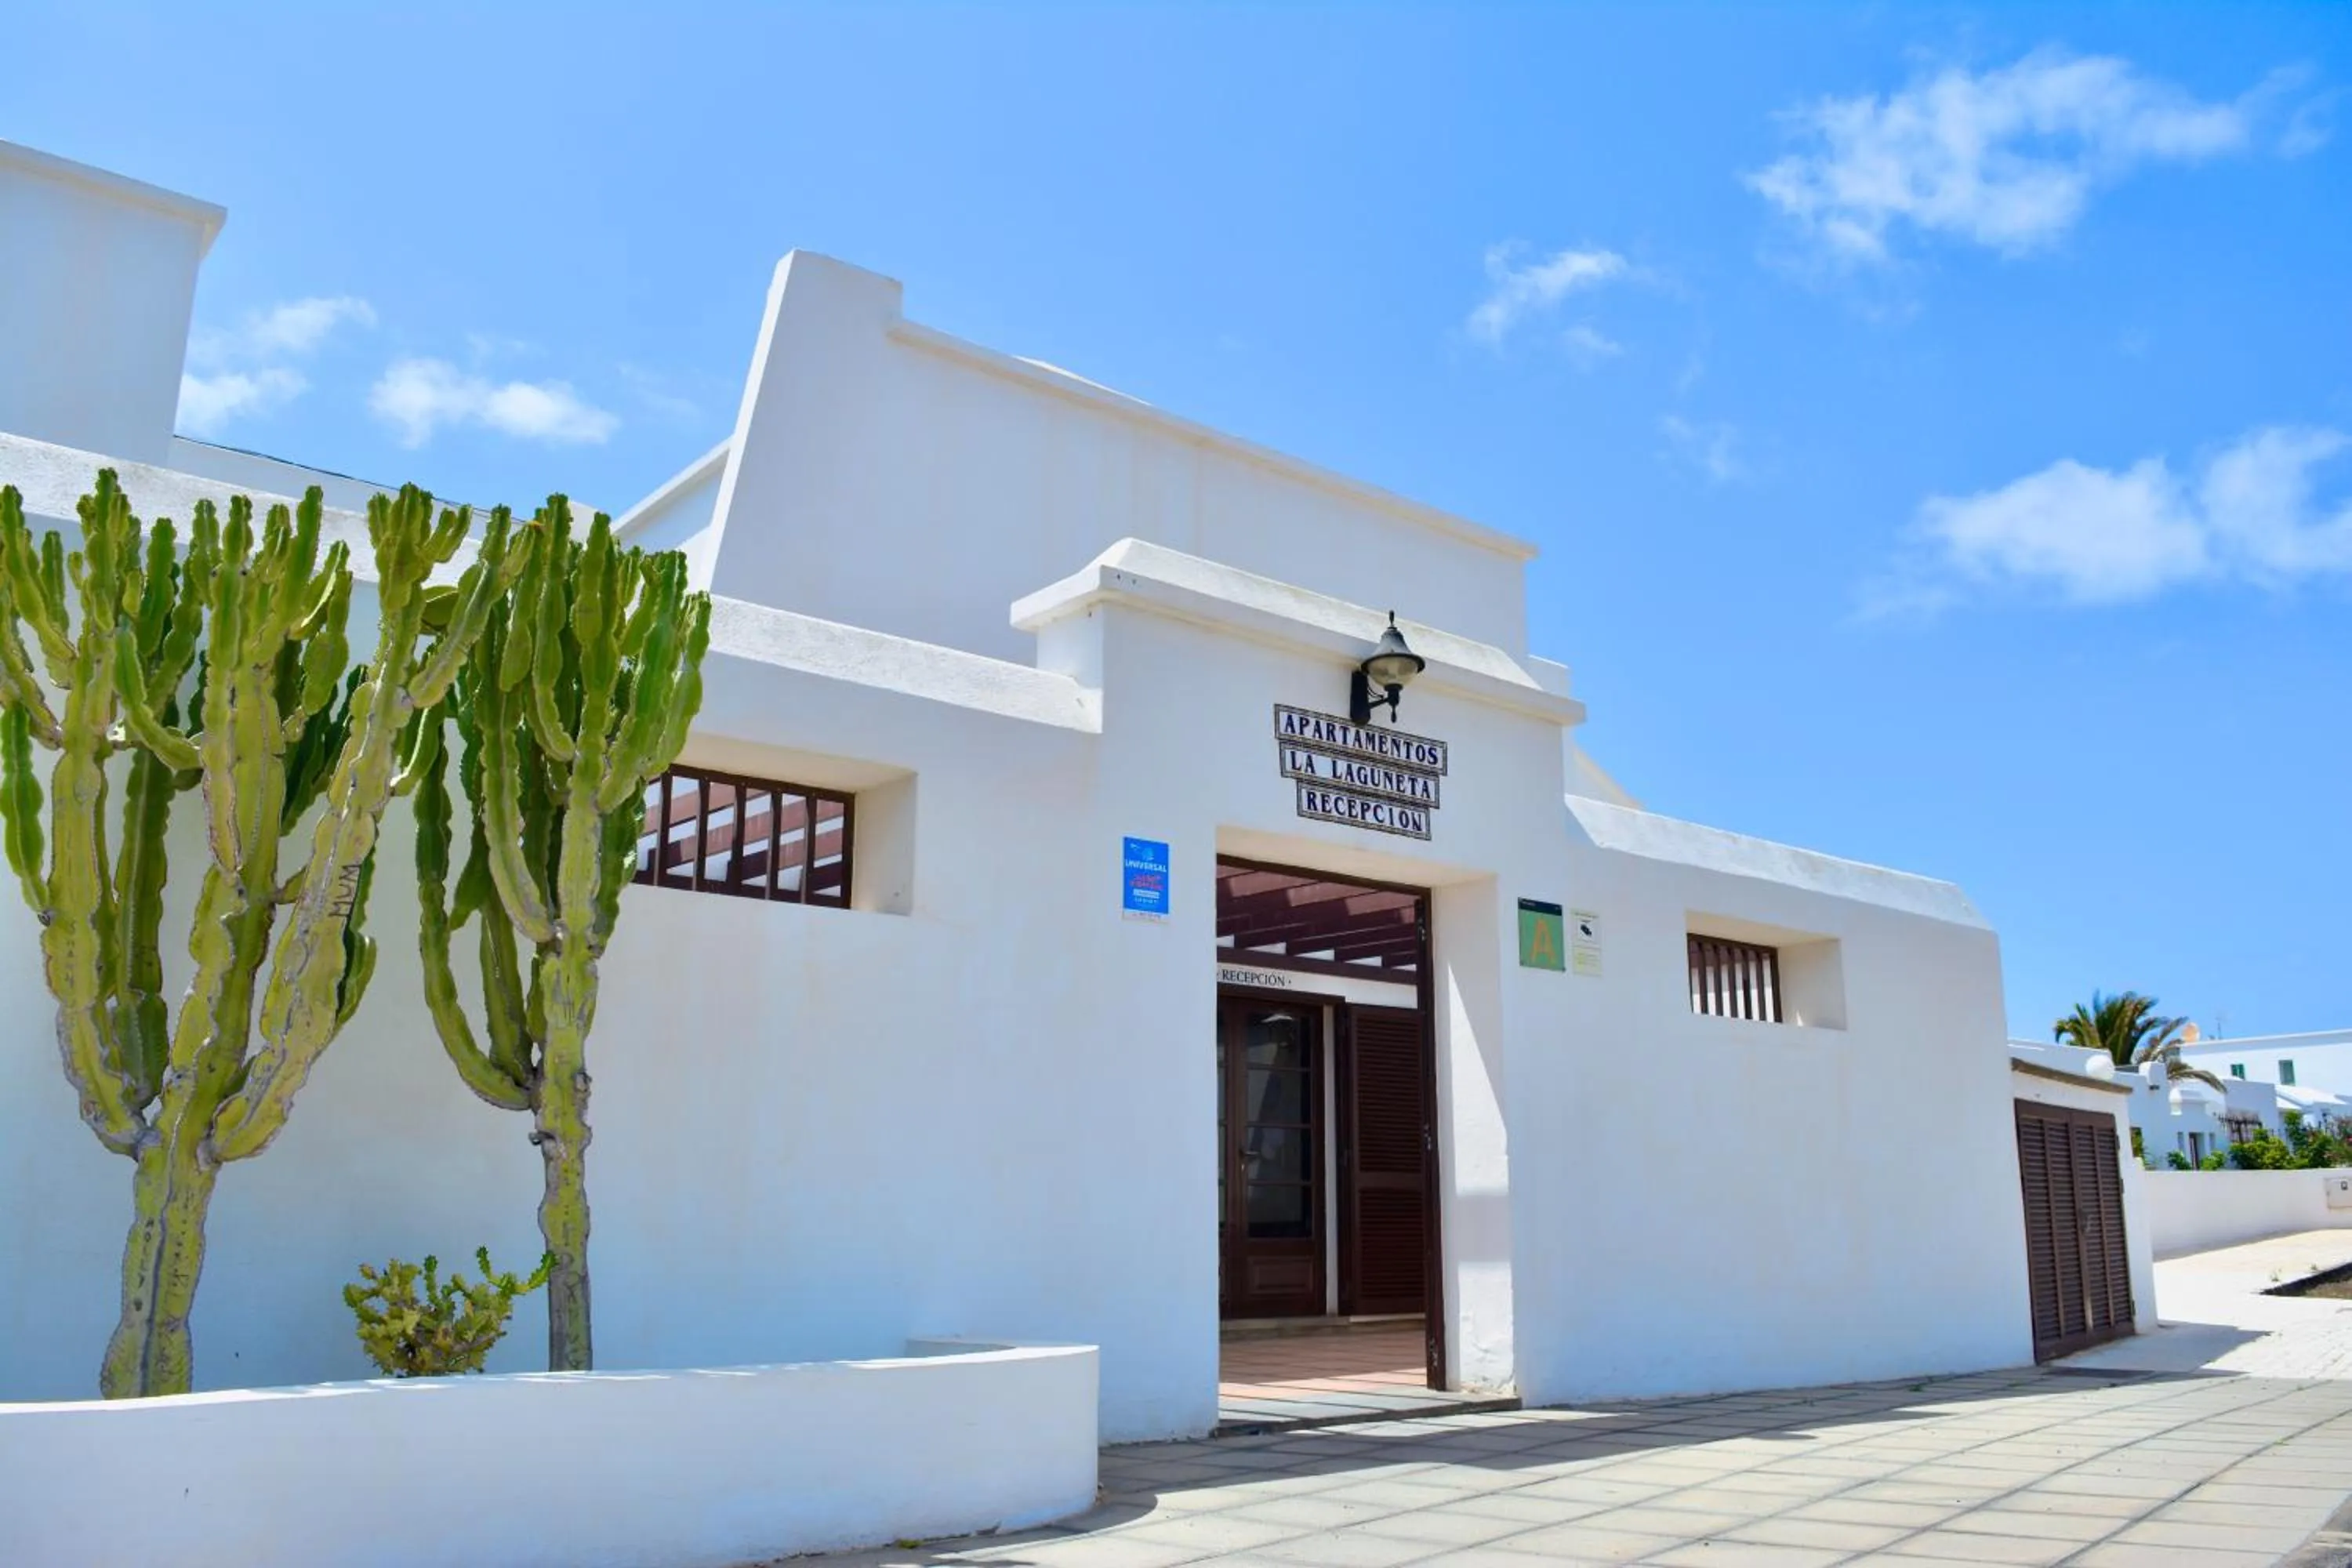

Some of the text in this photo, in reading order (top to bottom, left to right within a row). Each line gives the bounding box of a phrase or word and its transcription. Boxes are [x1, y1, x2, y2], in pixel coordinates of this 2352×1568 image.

[1285, 714, 1439, 765] APARTAMENTOS
[1290, 751, 1431, 798] LA LAGUNETA
[1307, 791, 1422, 831] RECEPCION
[1125, 858, 1167, 873] UNIVERSAL
[328, 865, 361, 916] MUM
[1222, 969, 1286, 986] RECEPCIÓN
